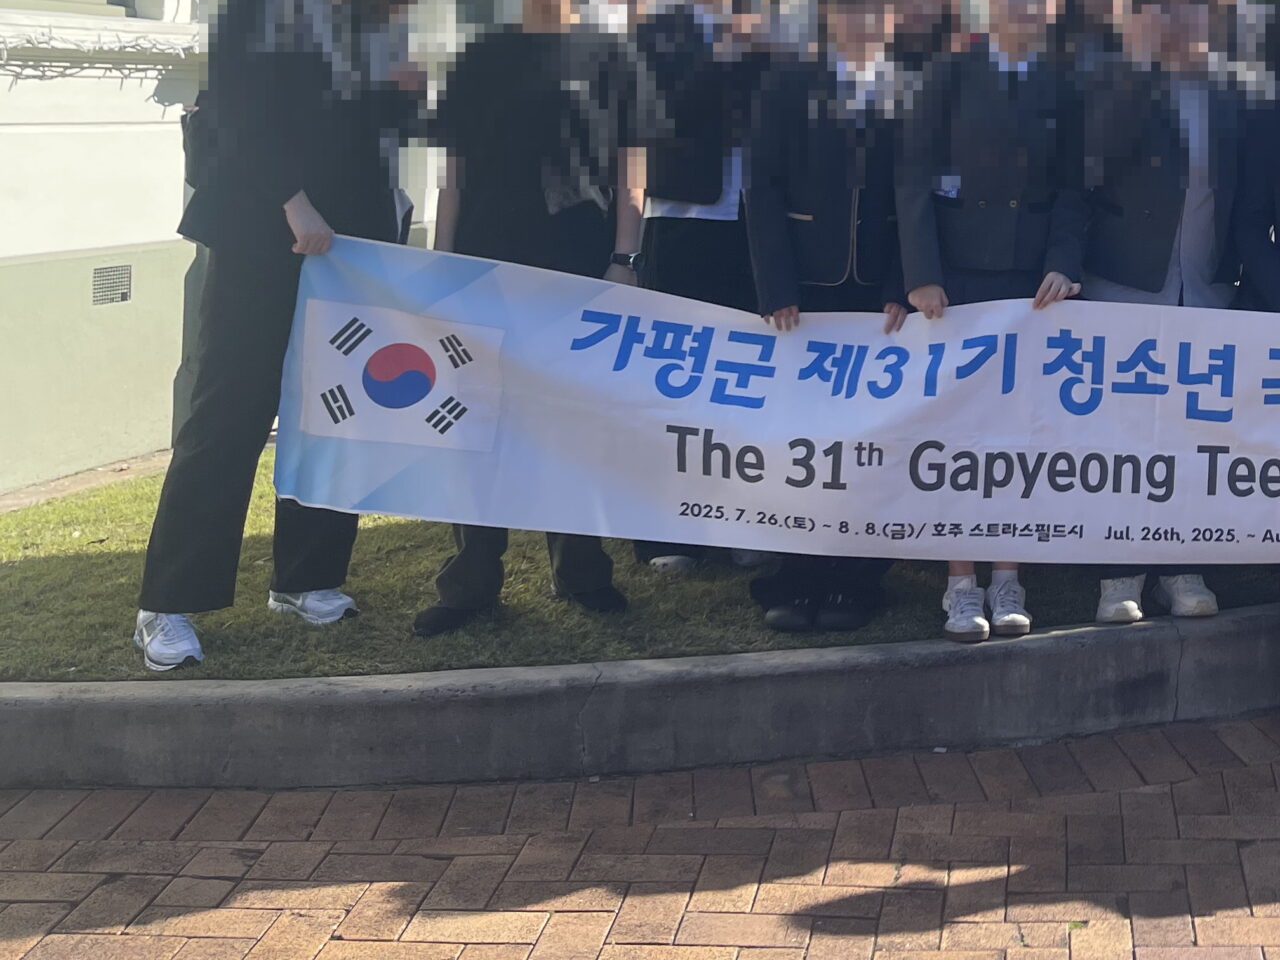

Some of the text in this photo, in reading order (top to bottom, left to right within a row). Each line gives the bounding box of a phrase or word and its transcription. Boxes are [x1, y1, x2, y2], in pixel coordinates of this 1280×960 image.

[570, 310, 777, 408] 가평군
[797, 333, 1018, 399] 제31기
[1043, 329, 1235, 422] 청소년
[666, 425, 764, 483] The
[785, 438, 883, 490] 31th
[909, 440, 1175, 502] Gapyeong
[680, 502, 728, 521] 2025.
[932, 522, 963, 537] 호주
[969, 524, 1083, 542] 스트라스필드시
[1105, 526, 1134, 541] Jul.
[1141, 527, 1184, 544] 26th,
[1192, 528, 1239, 543] 2025.
